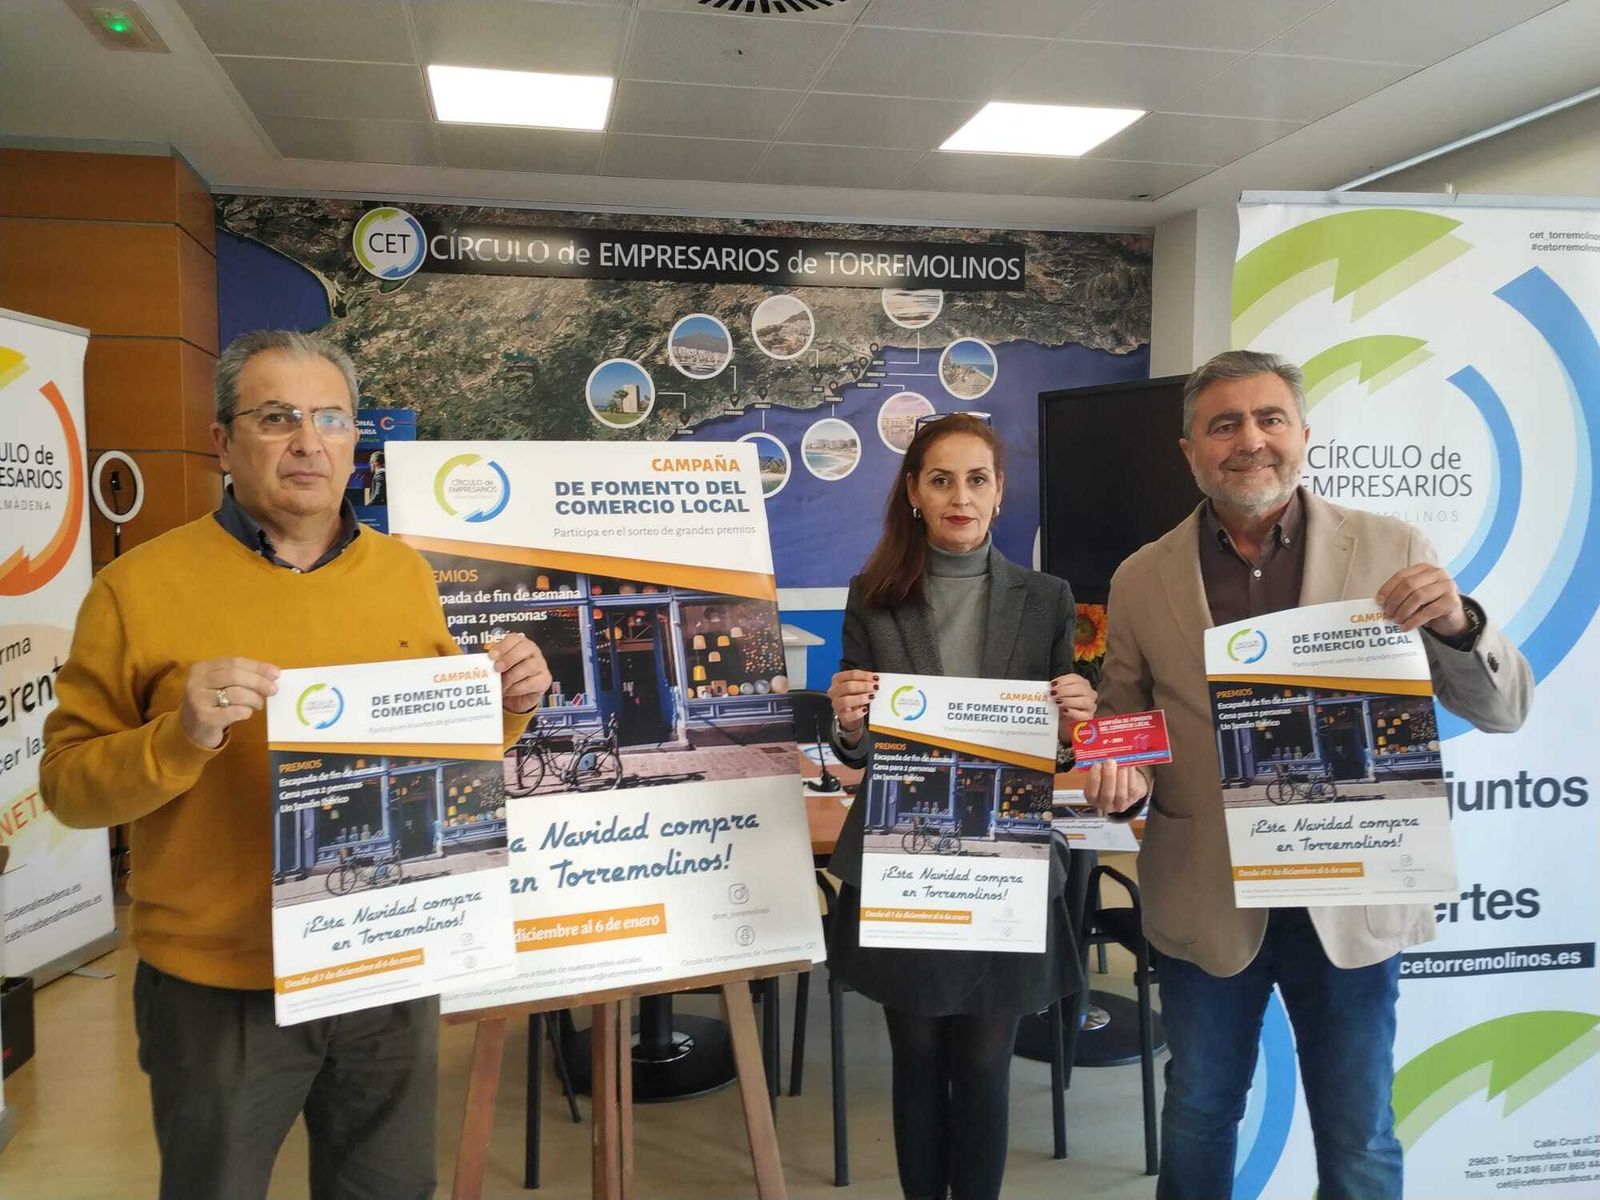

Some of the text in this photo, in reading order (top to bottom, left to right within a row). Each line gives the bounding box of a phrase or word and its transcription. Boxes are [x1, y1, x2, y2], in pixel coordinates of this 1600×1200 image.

[369, 233, 410, 253] CET
[430, 229, 1020, 280] CÍRCULO de EMPRESARIOS de TORREMOLINOS
[35, 445, 54, 465] de
[652, 455, 741, 472] CAMPAÑA
[1308, 439, 1461, 470] CÍRCULO de
[448, 486, 497, 494] EMPRESARIOS
[555, 481, 746, 496] DE FOMENTO DEL
[555, 499, 750, 515] COMERCIO LOCAL
[554, 526, 756, 539] Participa en el sorteo de grandes premios
[474, 590, 490, 603] de
[493, 589, 512, 602] fin
[513, 589, 530, 601] de
[532, 590, 582, 599] semana
[447, 611, 548, 627] para 2 personas
[1293, 625, 1402, 644] DE FOMENTO DE
[1293, 636, 1412, 654] COMERCIO LOCAL
[433, 667, 489, 684] CAMPAÑA
[372, 684, 490, 707] DE FOMENTO DEL
[1000, 692, 1048, 703] CAMPAÑA
[1216, 688, 1253, 698] PREMIOS
[372, 696, 492, 719] COMERCIO LOCAL
[949, 702, 1049, 715] DE FOMENTO DEL
[1238, 711, 1253, 719] para
[1259, 708, 1292, 717] personas
[947, 712, 1049, 725] COMERCIO LOCAL
[874, 742, 907, 750] PREMIOS
[279, 759, 322, 773] PREMIOS
[539, 812, 650, 850] Navidad
[660, 813, 760, 843] compra
[1293, 815, 1353, 832] Navidad
[1359, 817, 1420, 835] compra
[1276, 833, 1403, 852] en Torremolinos!
[550, 843, 732, 889] Torremolinos!
[919, 867, 970, 881] Navidad
[975, 872, 1024, 887] compra
[902, 885, 1009, 901] en Torremolinos!
[352, 897, 417, 925] Navidad
[422, 891, 483, 912] compra
[332, 910, 466, 951] en Torremolinos!
[514, 914, 660, 943] diciembre al 6 de enero
[1400, 951, 1582, 975] cetorremolinos.es
